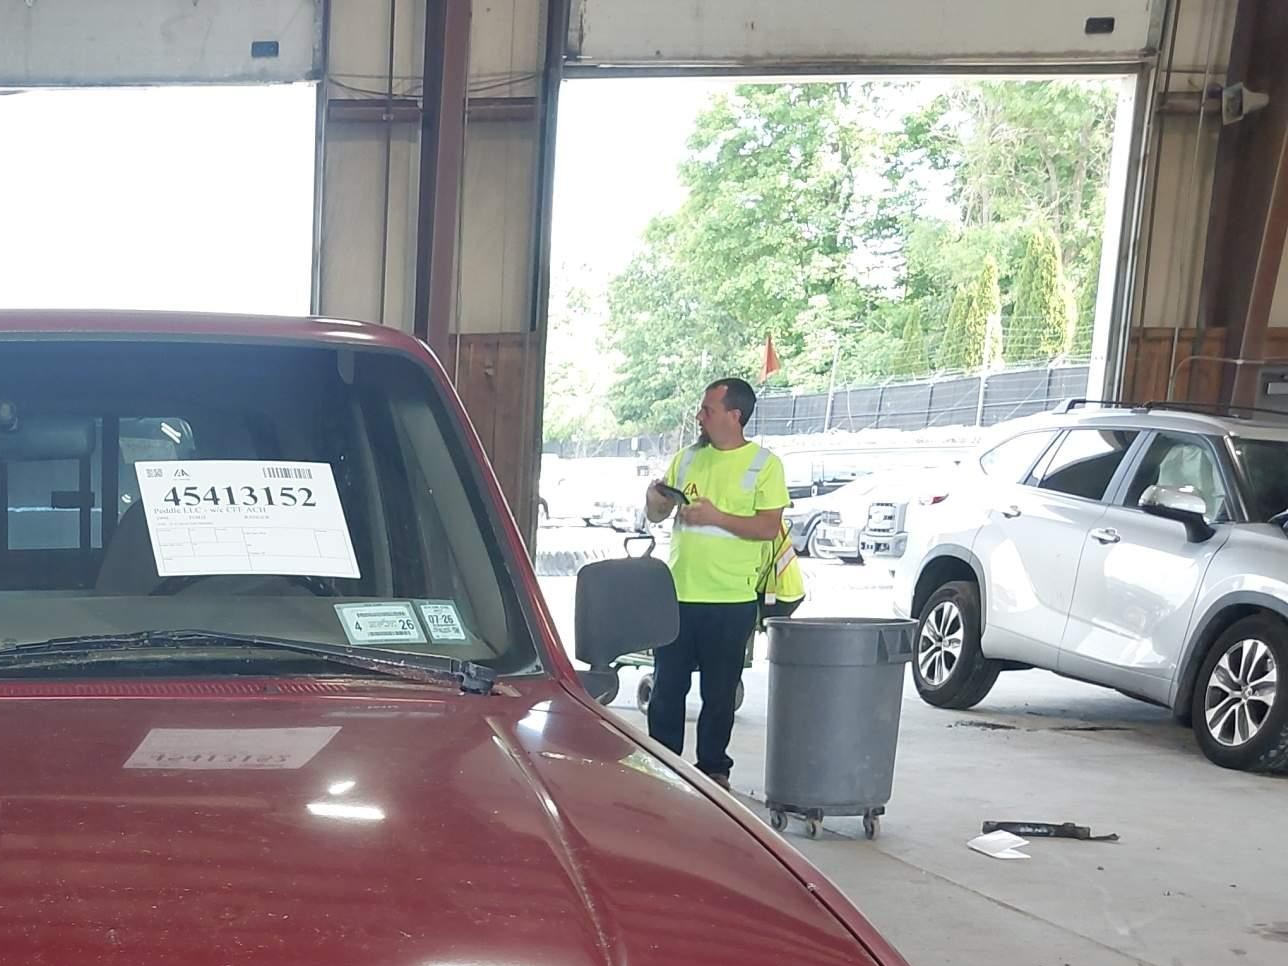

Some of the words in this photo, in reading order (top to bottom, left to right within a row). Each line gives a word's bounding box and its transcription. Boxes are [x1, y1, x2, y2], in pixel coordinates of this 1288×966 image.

[164, 486, 317, 507] 45413152
[355, 621, 362, 631] 4
[398, 619, 414, 630] 26
